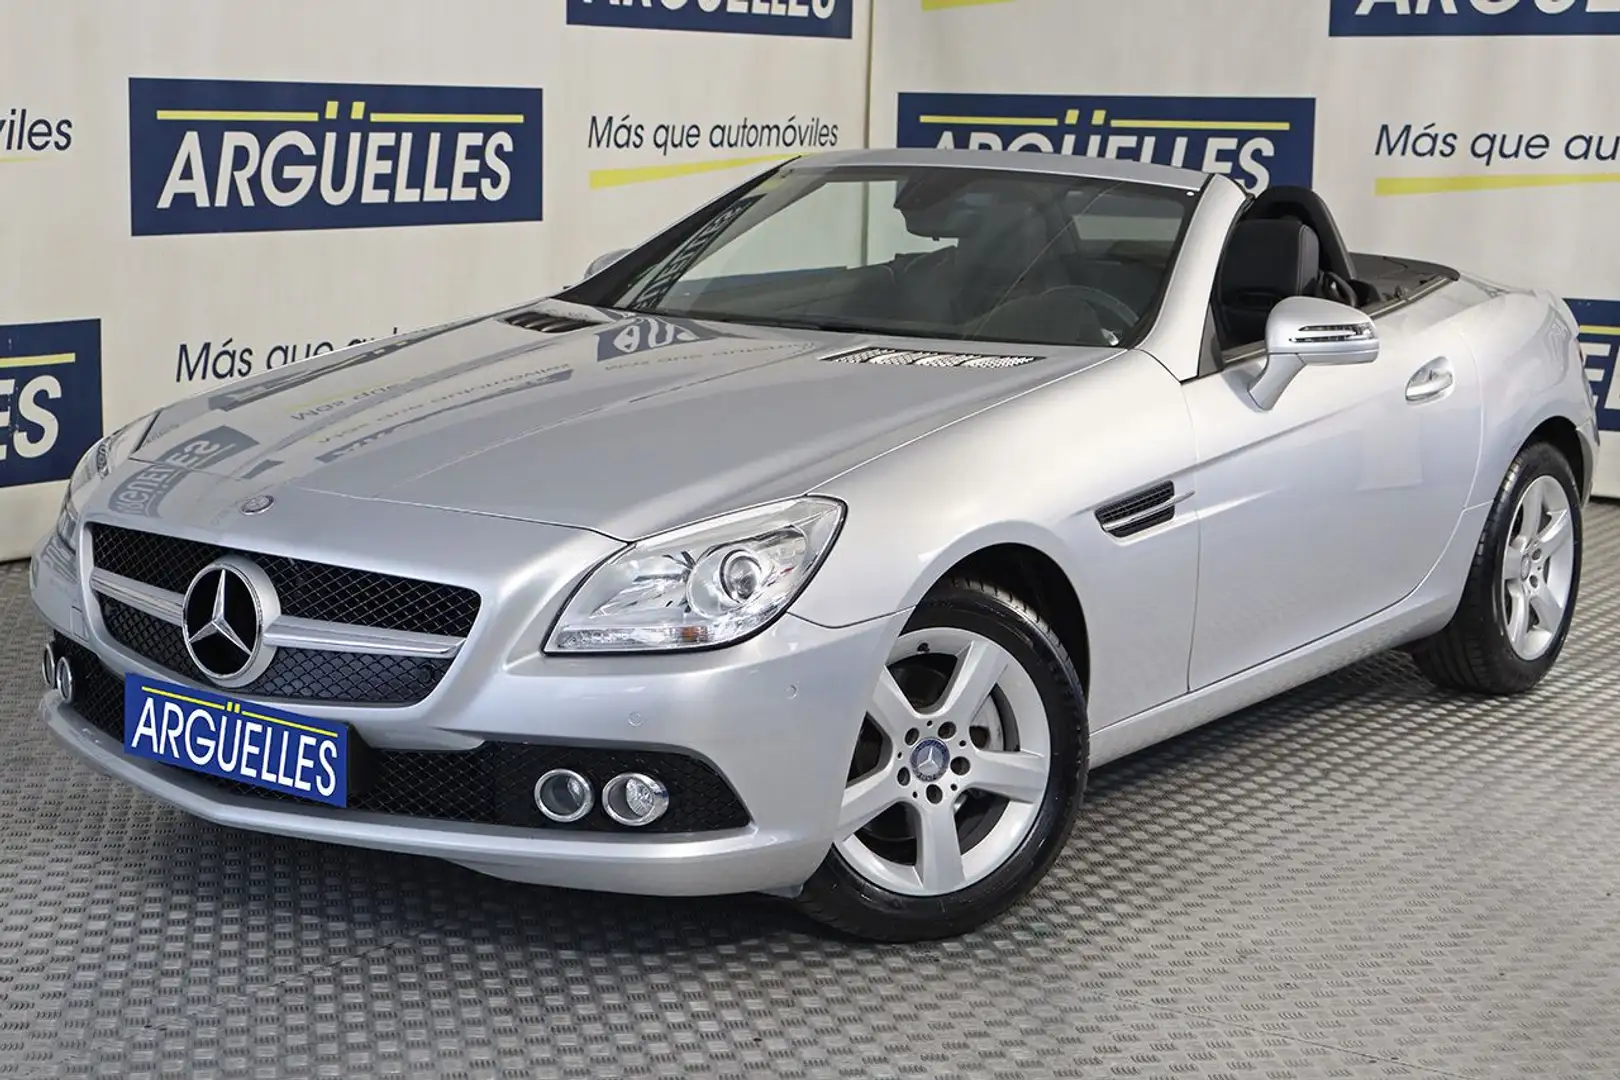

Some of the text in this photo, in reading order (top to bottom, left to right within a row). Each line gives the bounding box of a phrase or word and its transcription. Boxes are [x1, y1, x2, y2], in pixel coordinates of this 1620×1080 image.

[0, 108, 72, 151] iles
[588, 114, 839, 156] Más que automóviles
[1375, 122, 1458, 158] Más
[1470, 132, 1550, 166] que
[156, 101, 514, 208] ARGÜELLES
[176, 337, 253, 383] Más
[131, 697, 338, 797] ARGÜELLES
